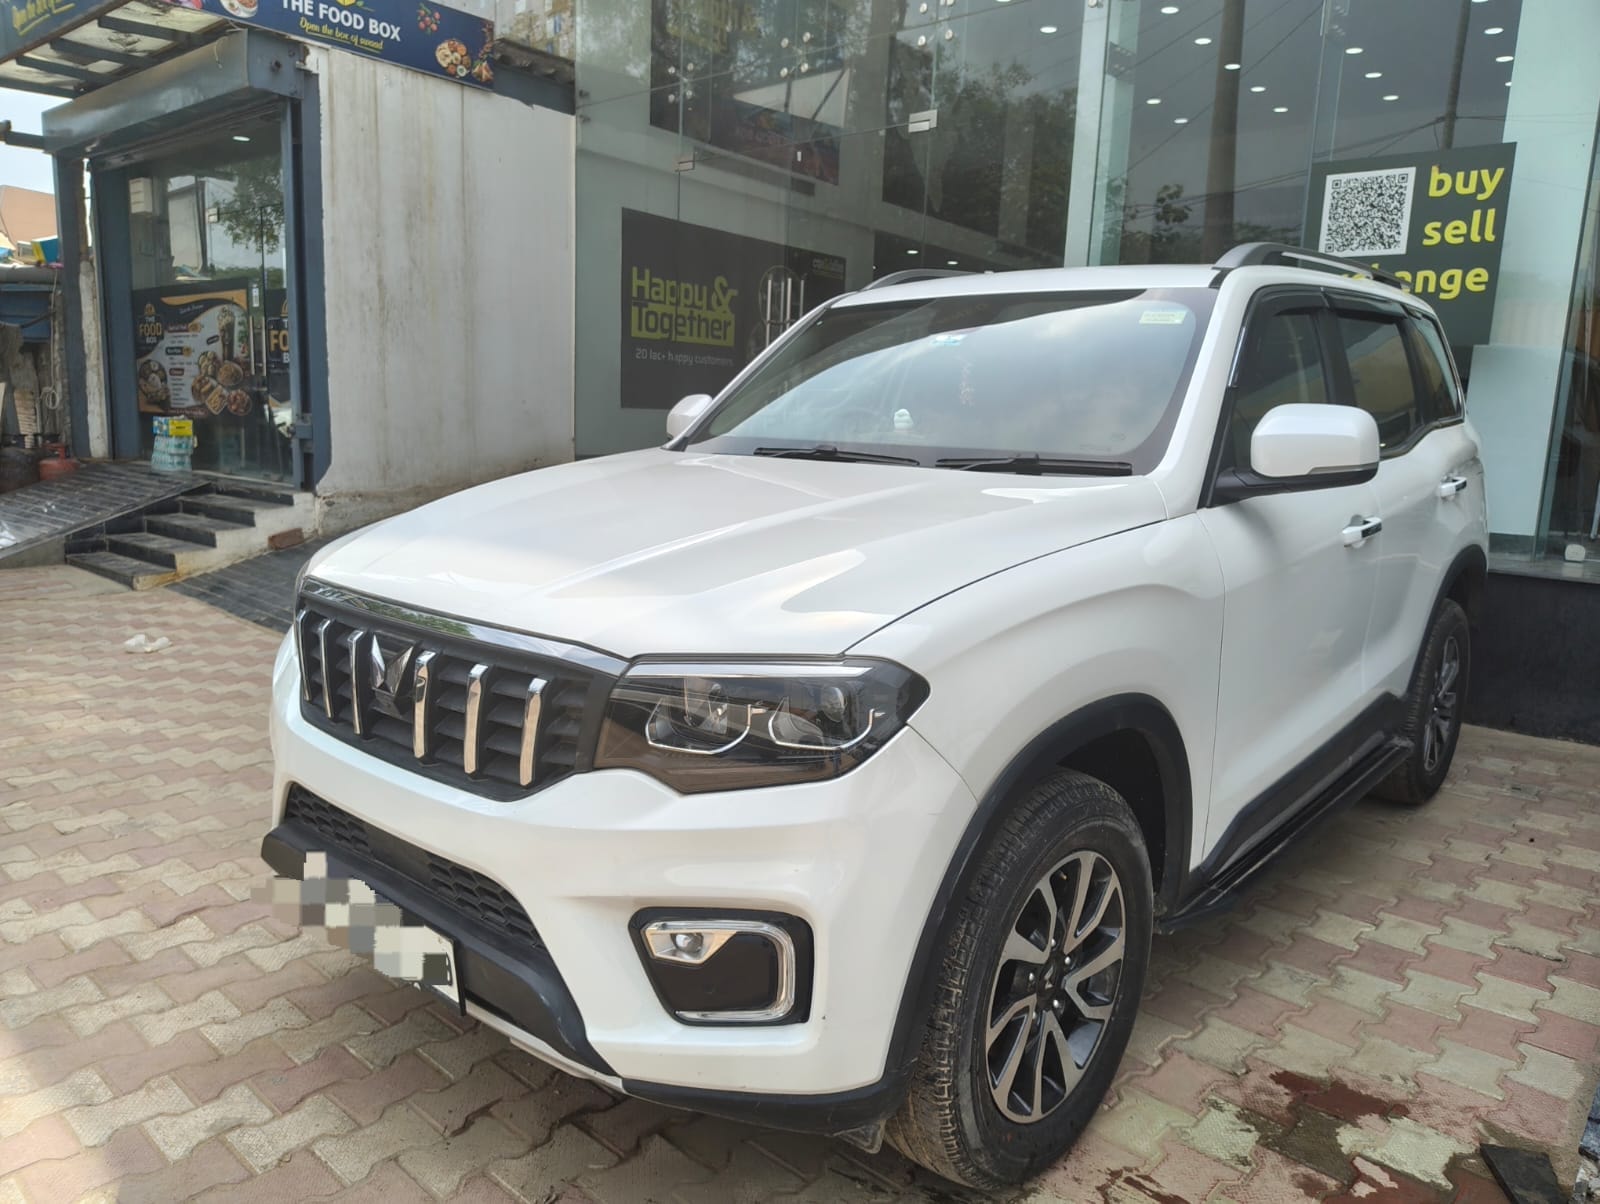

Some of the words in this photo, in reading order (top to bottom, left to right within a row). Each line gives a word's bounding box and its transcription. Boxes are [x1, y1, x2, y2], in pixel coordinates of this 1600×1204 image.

[319, 3, 365, 30] FOOD
[369, 18, 401, 41] BOX
[1428, 165, 1504, 200] buy
[1422, 208, 1496, 246] sell
[632, 266, 707, 311] Happy
[712, 275, 738, 313] &
[139, 322, 162, 337] FOOD
[632, 302, 731, 342] Together
[635, 347, 648, 360] 20
